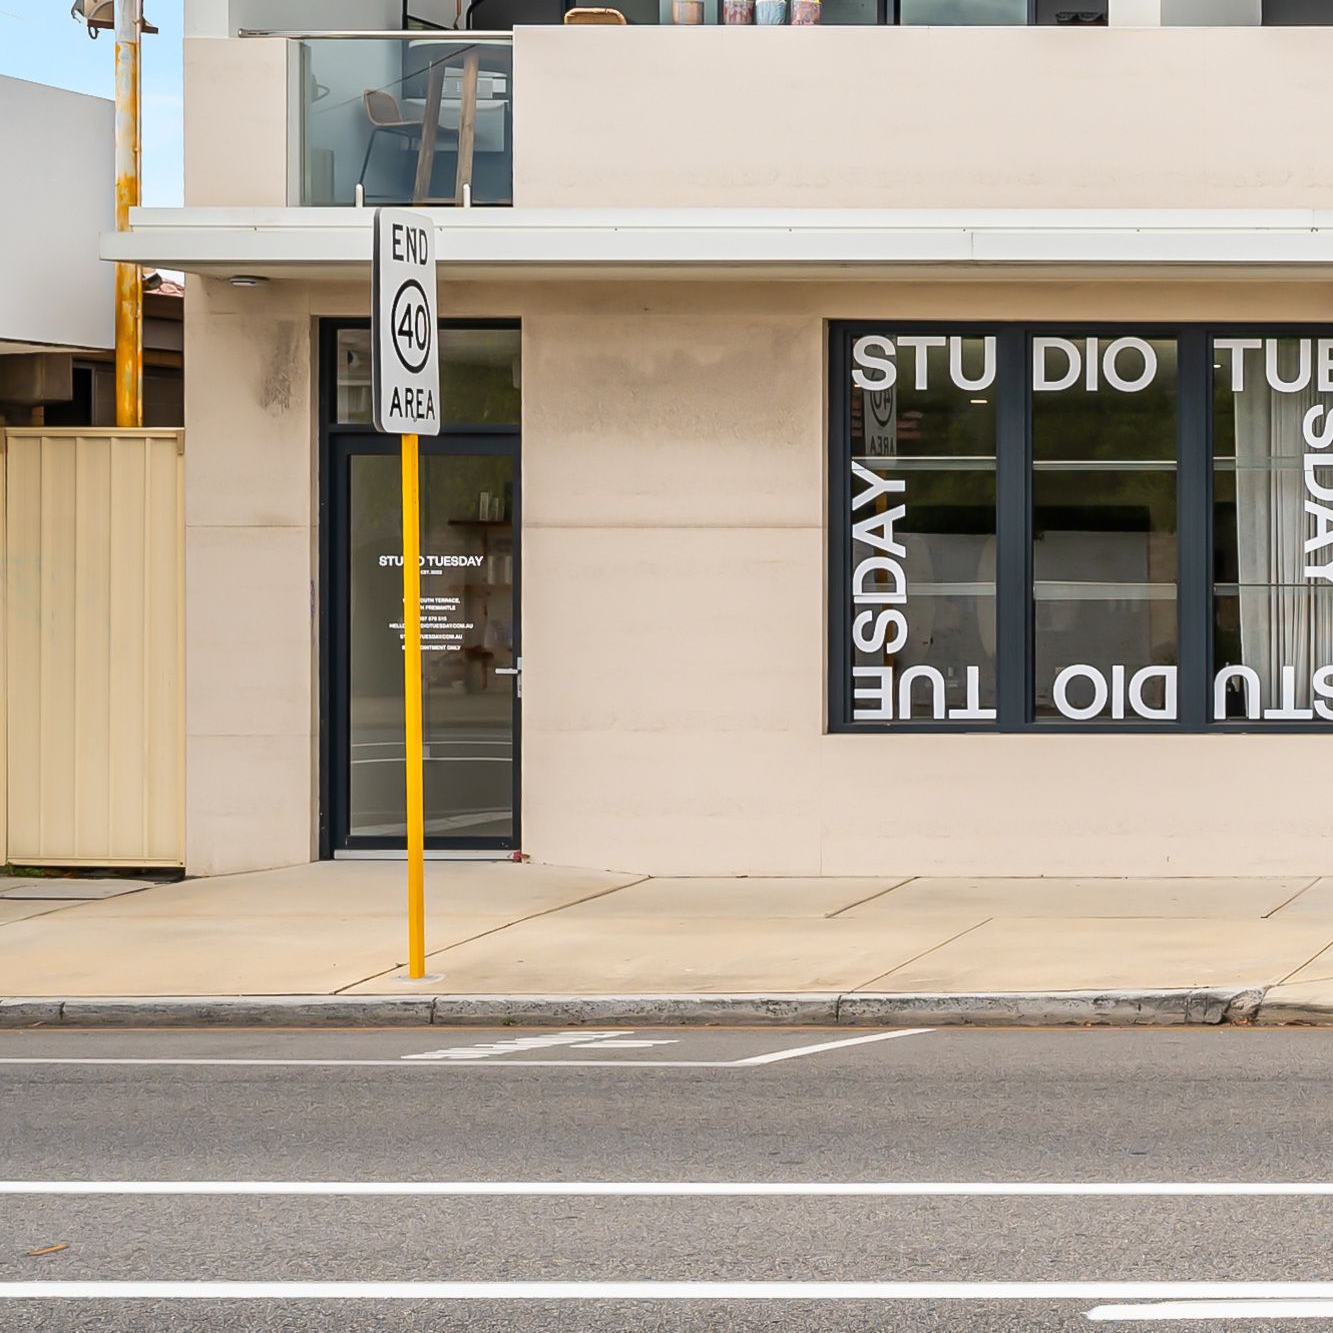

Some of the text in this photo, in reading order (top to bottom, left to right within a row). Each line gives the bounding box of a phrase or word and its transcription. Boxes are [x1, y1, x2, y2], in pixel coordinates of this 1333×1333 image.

[392, 223, 428, 266] END
[397, 303, 427, 351] 40
[389, 386, 435, 420] AREA
[426, 555, 484, 566] TUESDAY
